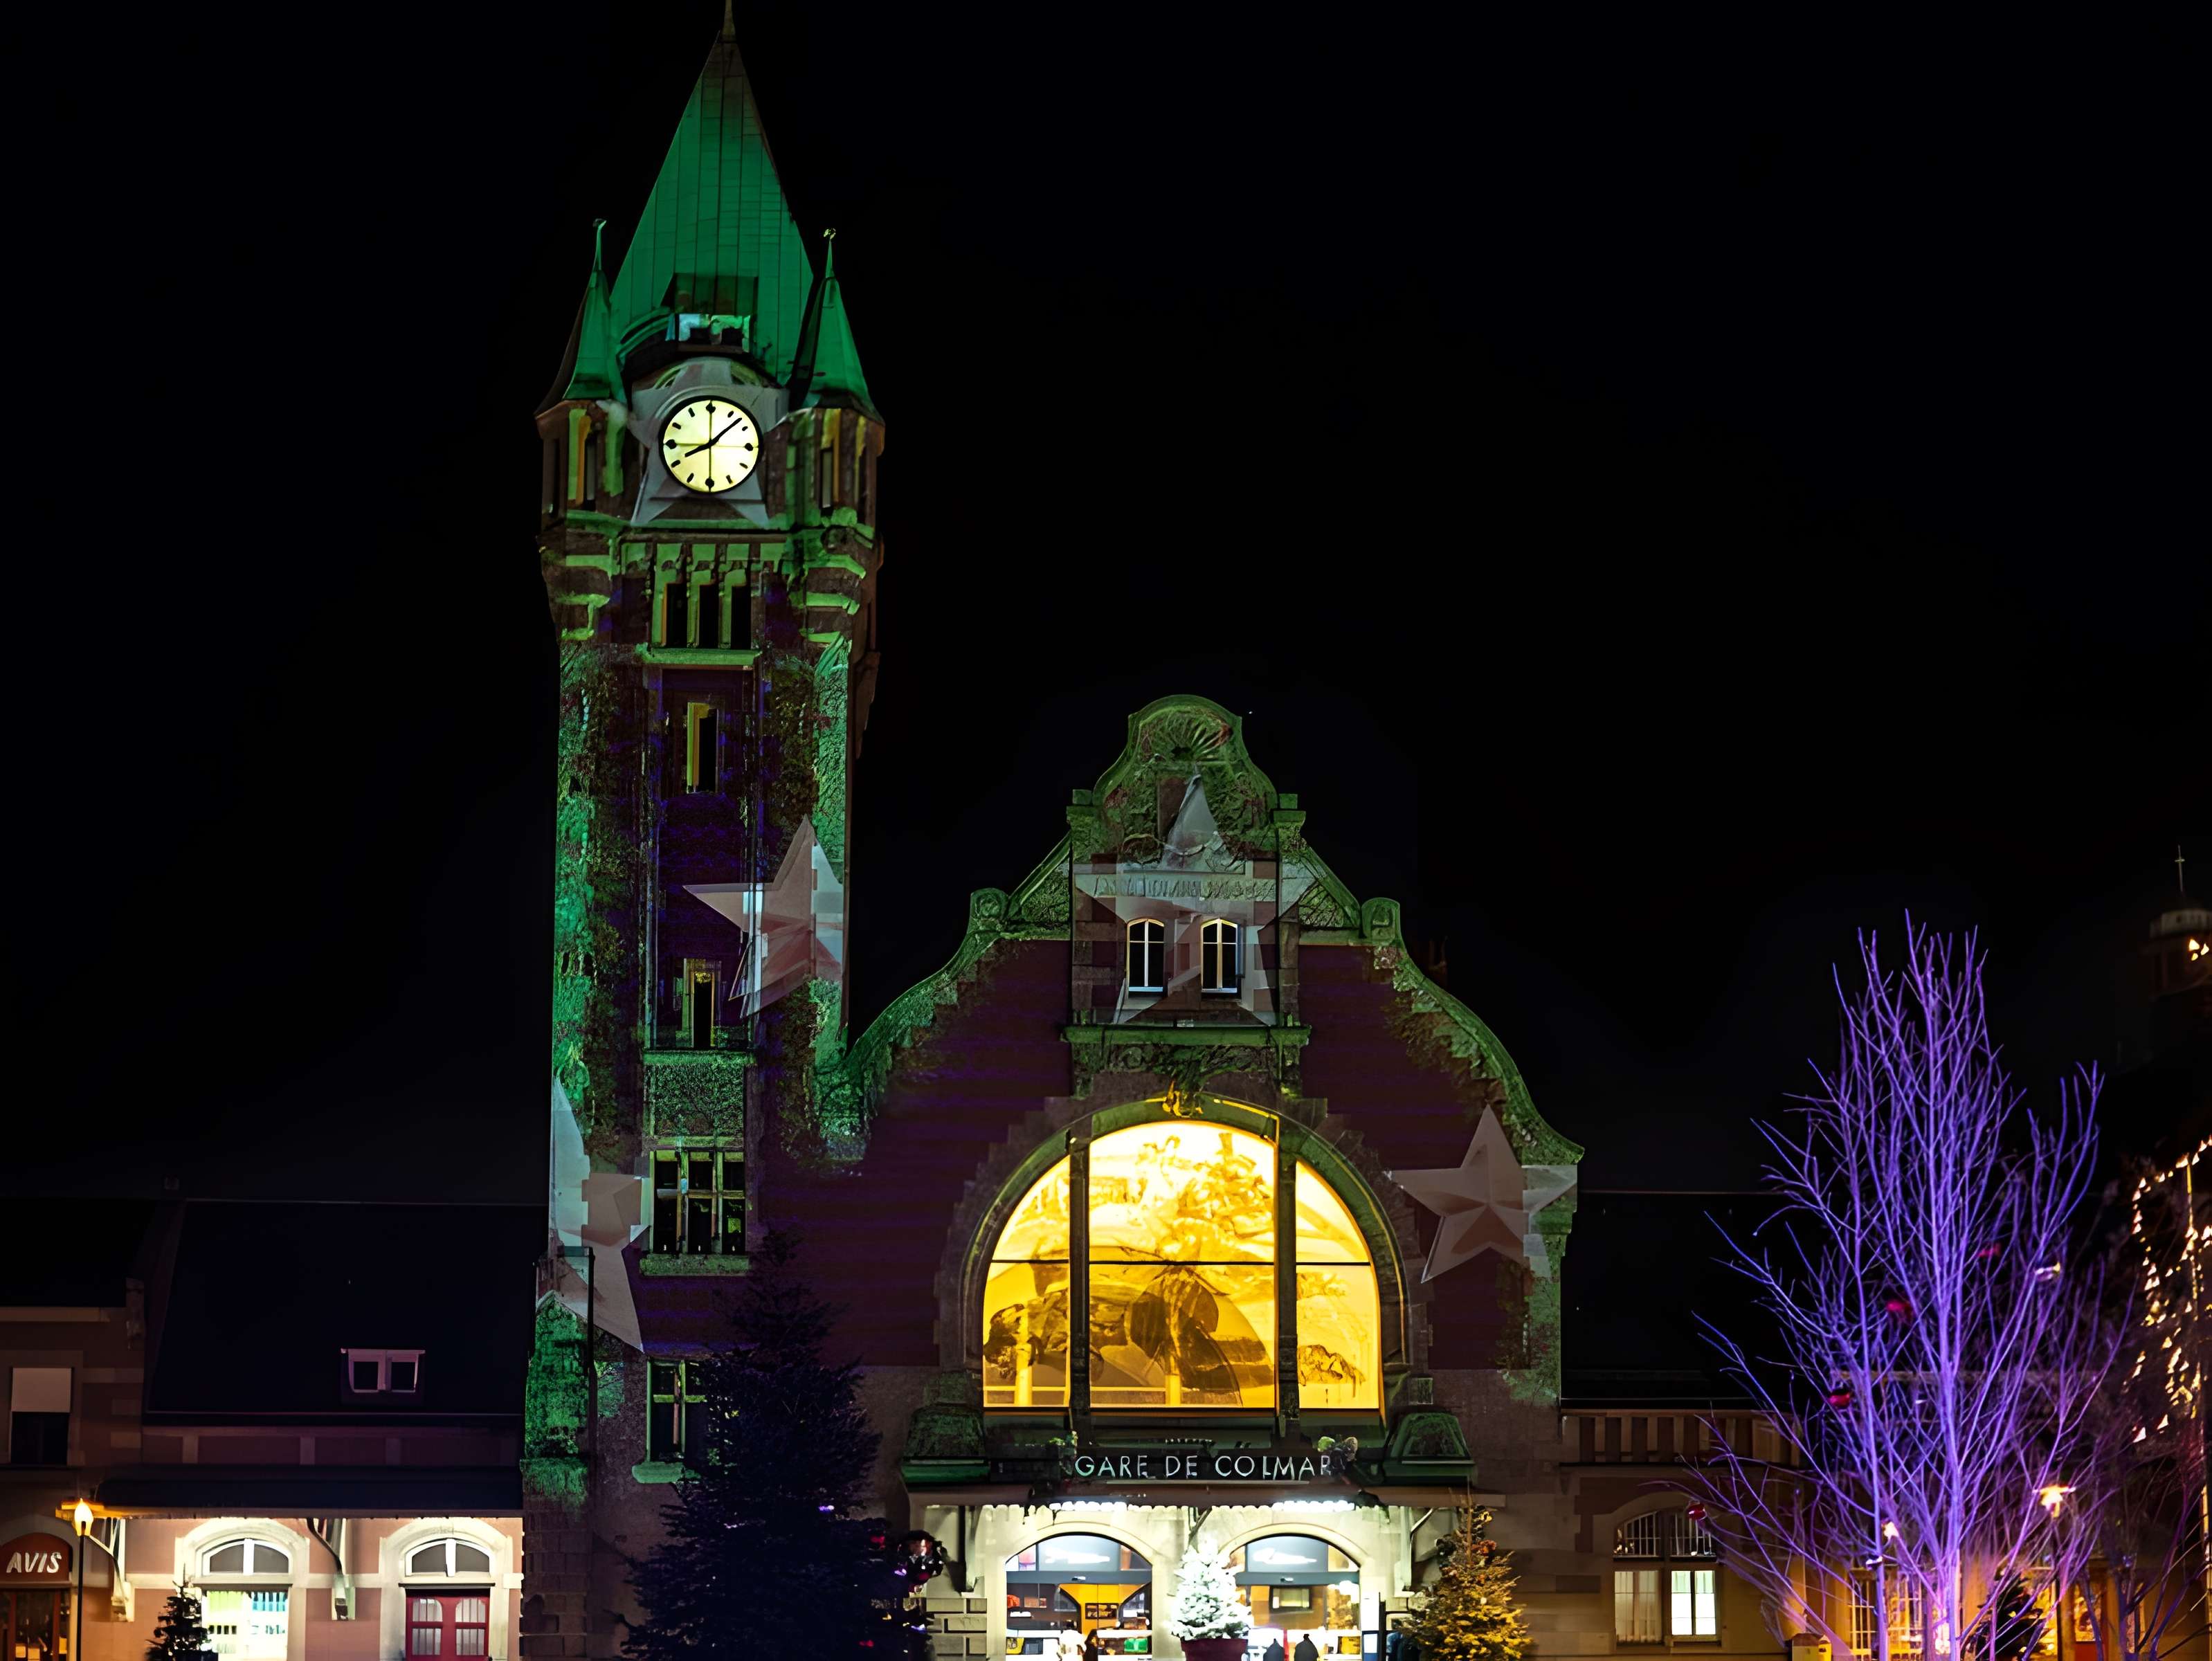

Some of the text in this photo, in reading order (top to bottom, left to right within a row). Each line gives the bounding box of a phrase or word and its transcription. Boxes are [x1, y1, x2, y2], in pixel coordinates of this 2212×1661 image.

[1074, 1455, 1332, 1480] GARE DE COLMAR
[6, 1551, 62, 1574] AVIS
